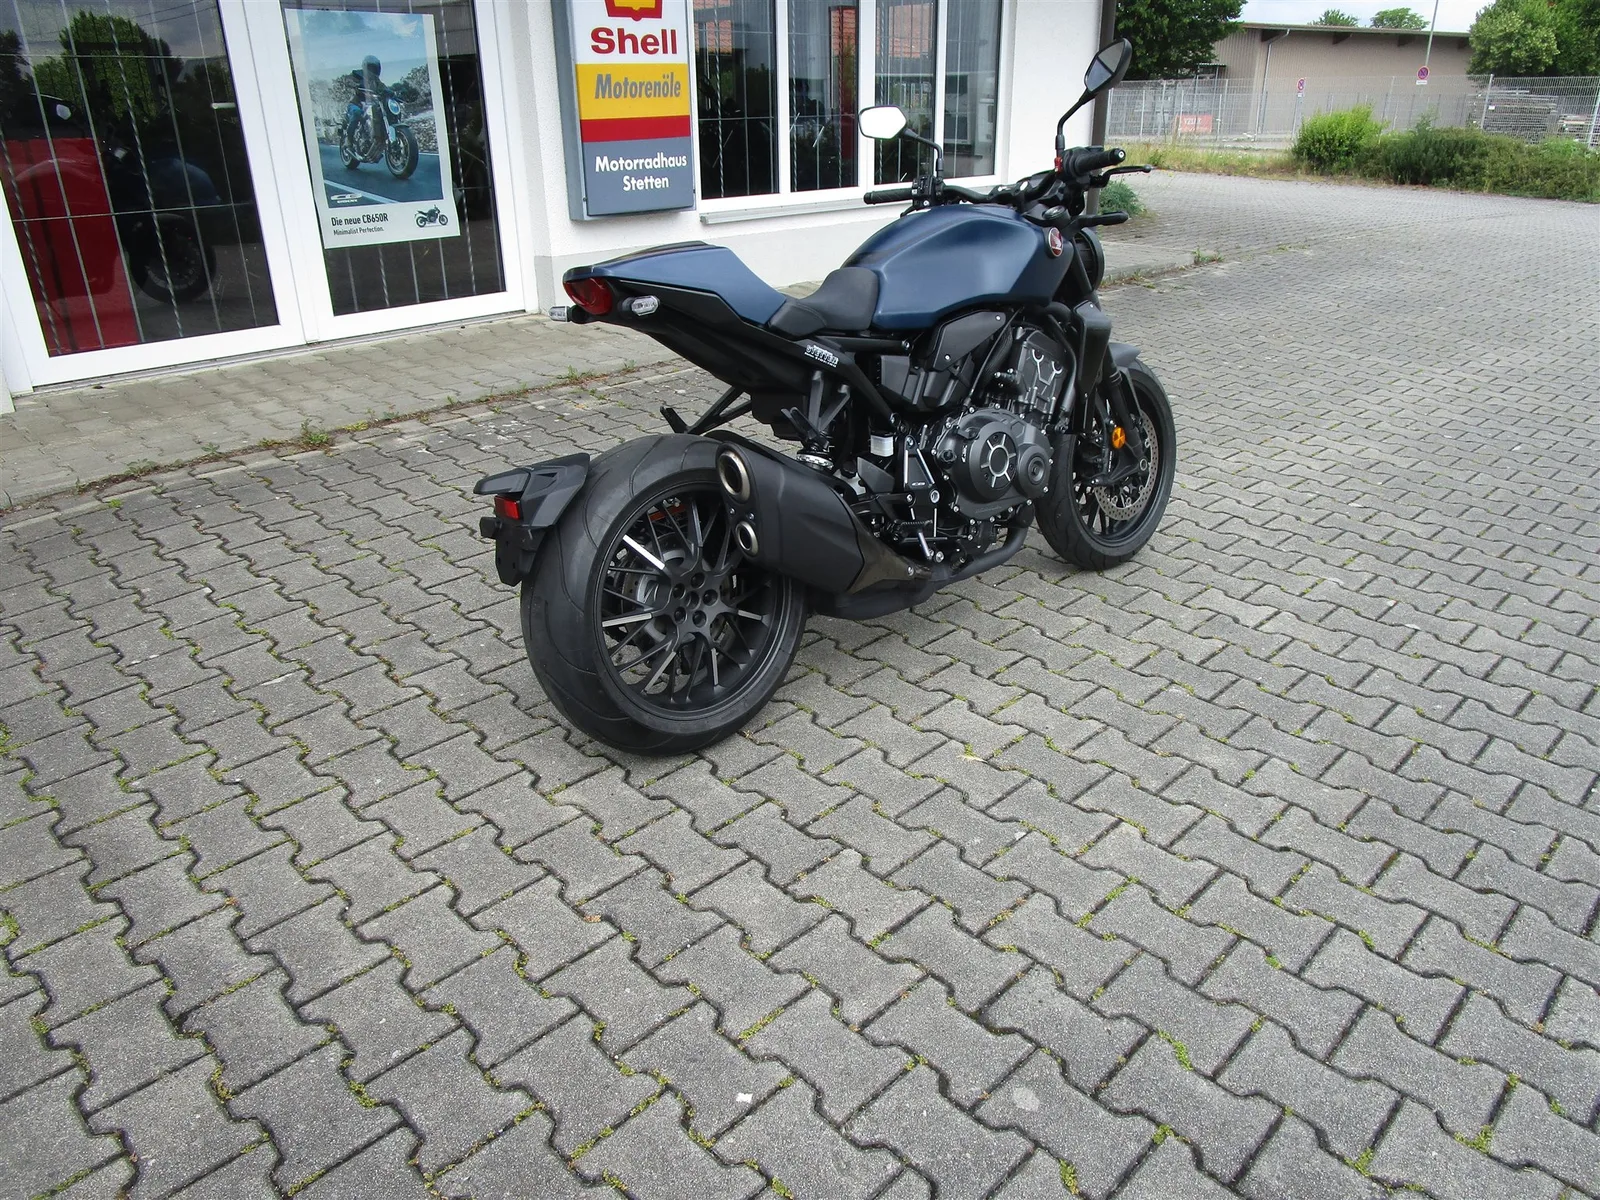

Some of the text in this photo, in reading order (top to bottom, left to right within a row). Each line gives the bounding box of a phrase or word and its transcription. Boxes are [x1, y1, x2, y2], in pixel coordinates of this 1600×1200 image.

[591, 27, 677, 55] Shell
[595, 72, 681, 99] Motorenöle
[595, 152, 687, 172] Motorradhaus
[623, 175, 669, 191] Stetten
[331, 213, 388, 227] Die neue CB650R
[333, 227, 359, 236] Minimalist
